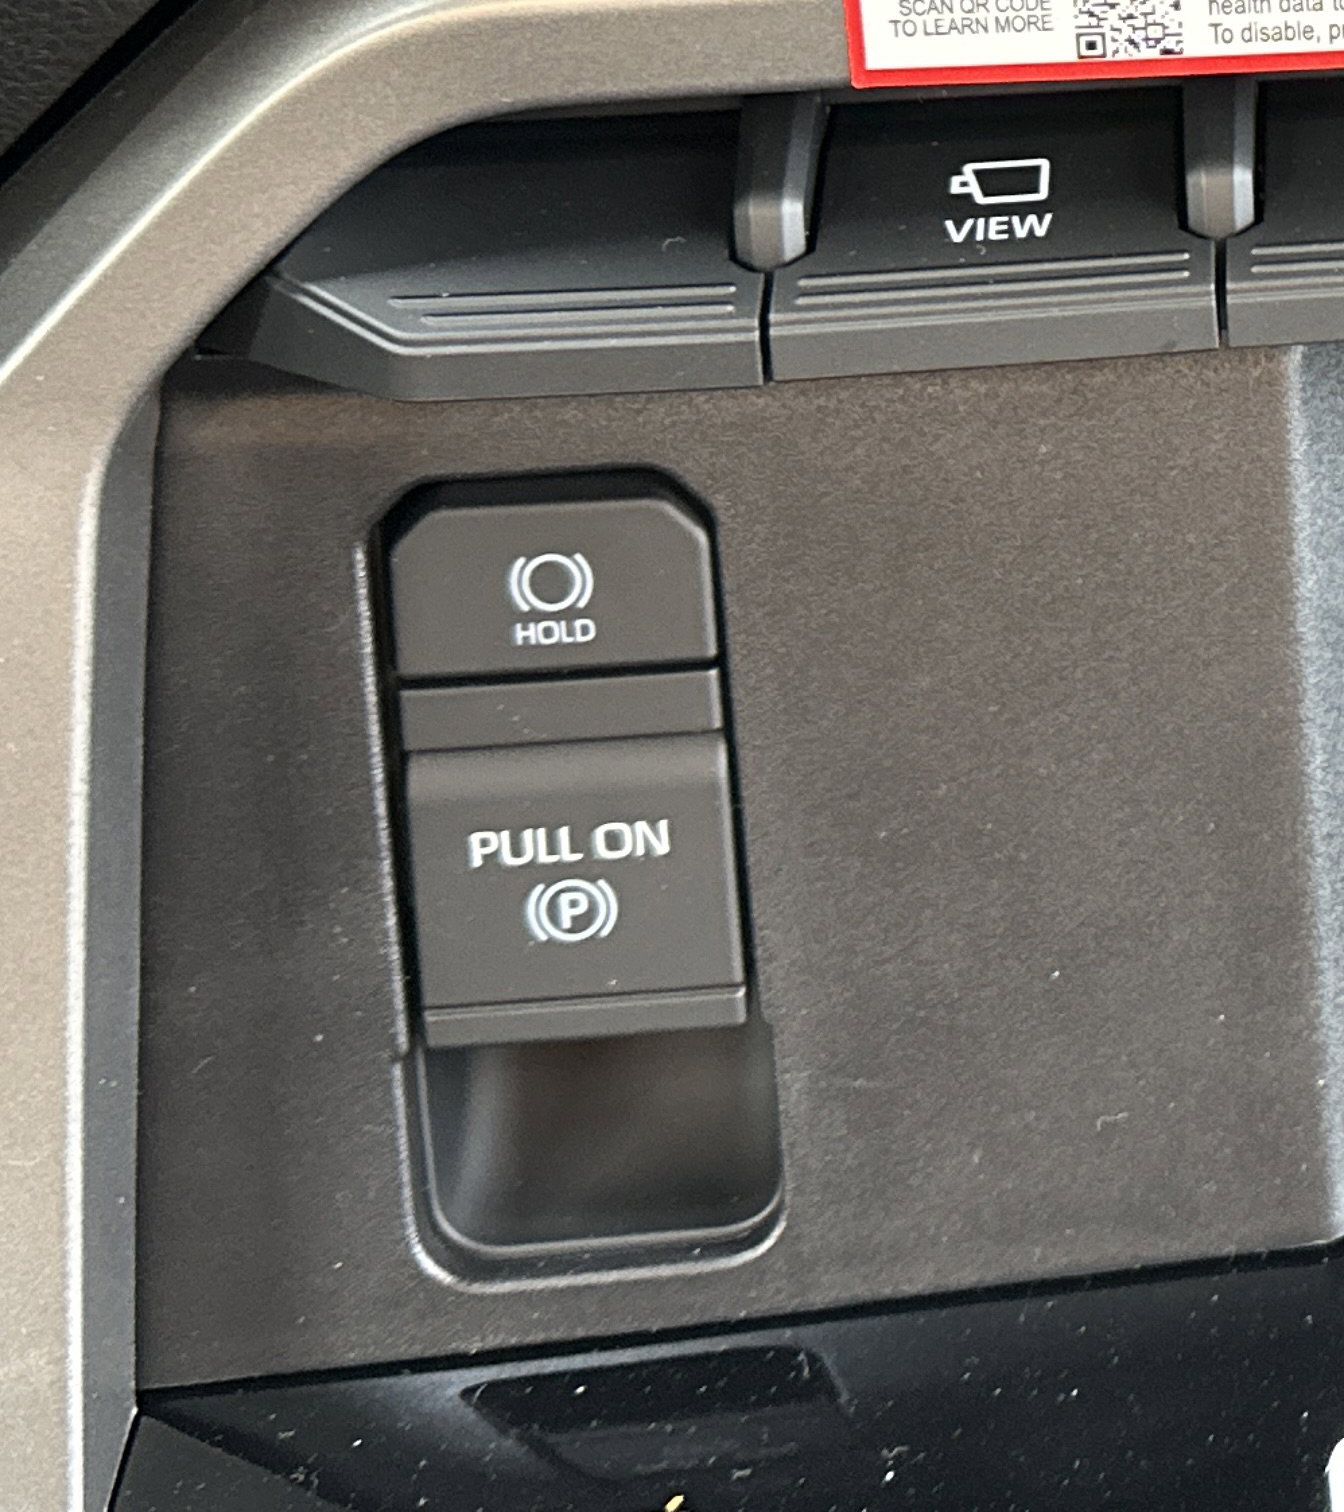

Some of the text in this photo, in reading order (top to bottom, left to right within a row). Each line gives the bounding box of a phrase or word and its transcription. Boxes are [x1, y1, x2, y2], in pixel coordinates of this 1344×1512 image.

[888, 14, 1054, 38] TO LEARN MORE
[1208, 22, 1235, 45] To
[1240, 18, 1321, 44] disable,
[943, 211, 1054, 244] VIEW
[511, 618, 597, 646] HOLD
[468, 818, 671, 869] PULL ON
[556, 890, 590, 931] P
